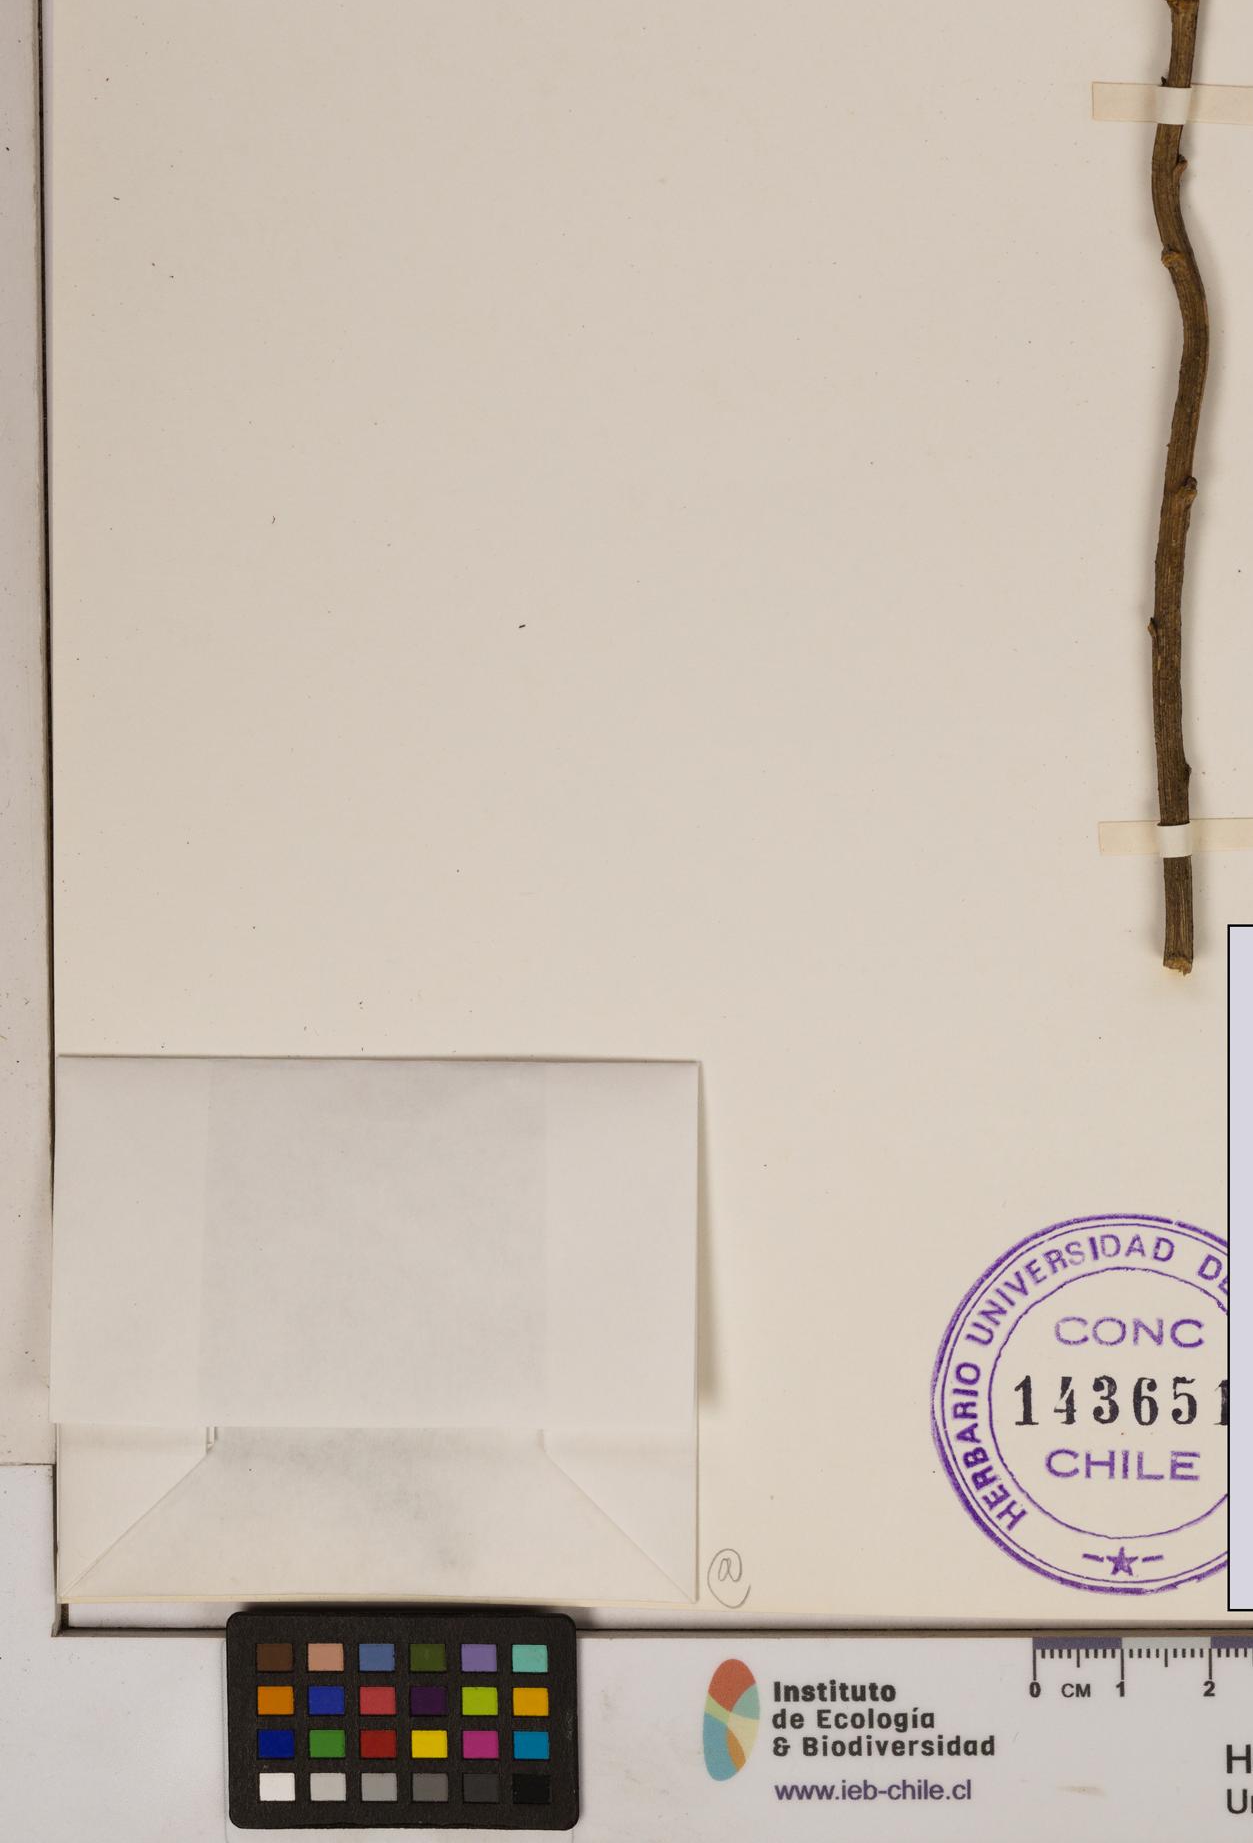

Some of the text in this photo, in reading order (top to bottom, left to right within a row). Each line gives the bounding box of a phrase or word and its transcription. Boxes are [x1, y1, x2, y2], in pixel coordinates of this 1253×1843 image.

[966, 1234, 1176, 1347] UNIVERSIDAD
[1053, 1316, 1205, 1348] CONC
[952, 1360, 1029, 1532] HERBARIO
[1044, 1448, 1201, 1482] CHILE
[773, 1679, 897, 1703] Instituto
[1029, 1681, 1042, 1699] 0
[1061, 1682, 1091, 1699] CM
[1115, 1680, 1126, 1698] 1
[1203, 1680, 1216, 1698] 2
[771, 1706, 935, 1734] de Ecología
[772, 1734, 995, 1757] & Biodiversidad
[774, 1778, 972, 1801] www.ieb-chile.cl
